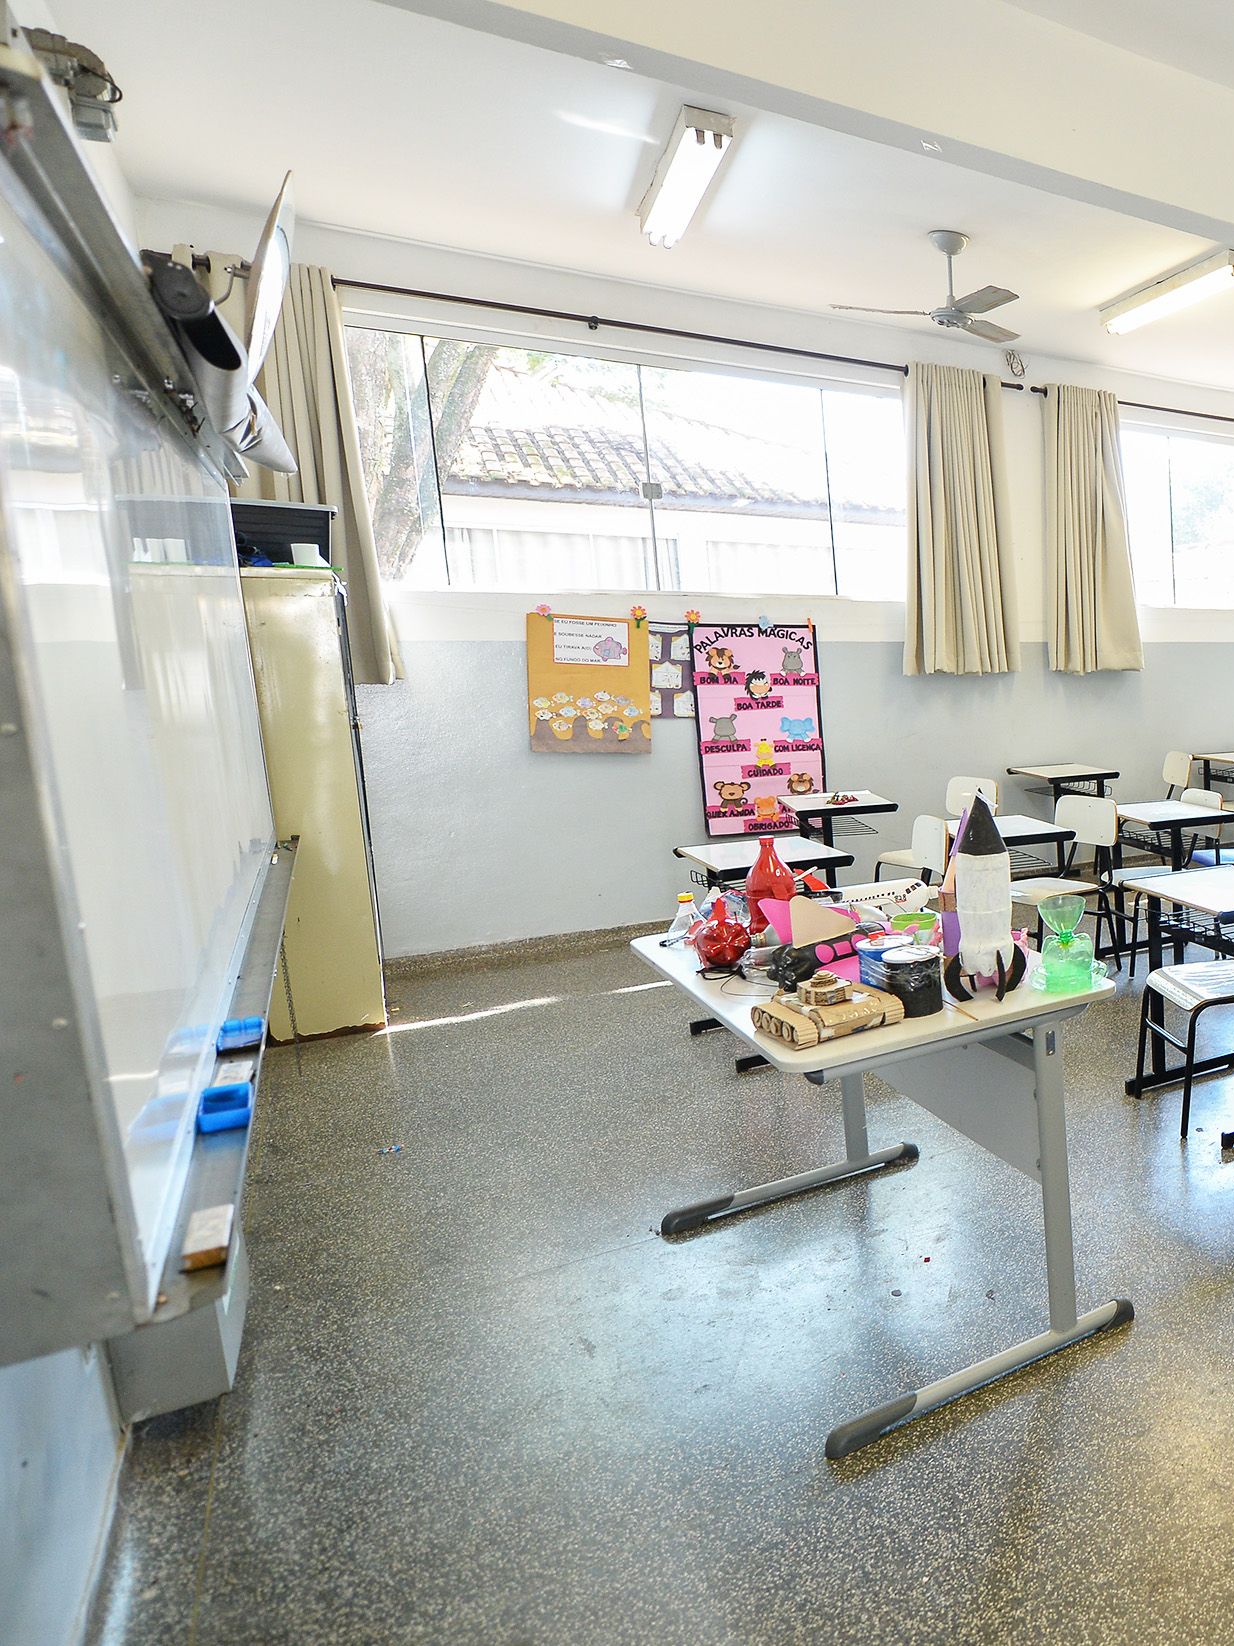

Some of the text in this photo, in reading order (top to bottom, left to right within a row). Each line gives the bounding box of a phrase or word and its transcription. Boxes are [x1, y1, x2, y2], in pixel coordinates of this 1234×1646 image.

[694, 627, 754, 654] PALAVRAS
[700, 676, 720, 684] BOM
[704, 744, 747, 753] DESCULPA
[791, 743, 821, 752] LICENÇA
[748, 768, 783, 777] CUIDADO
[748, 821, 790, 831] OBRIGADO
